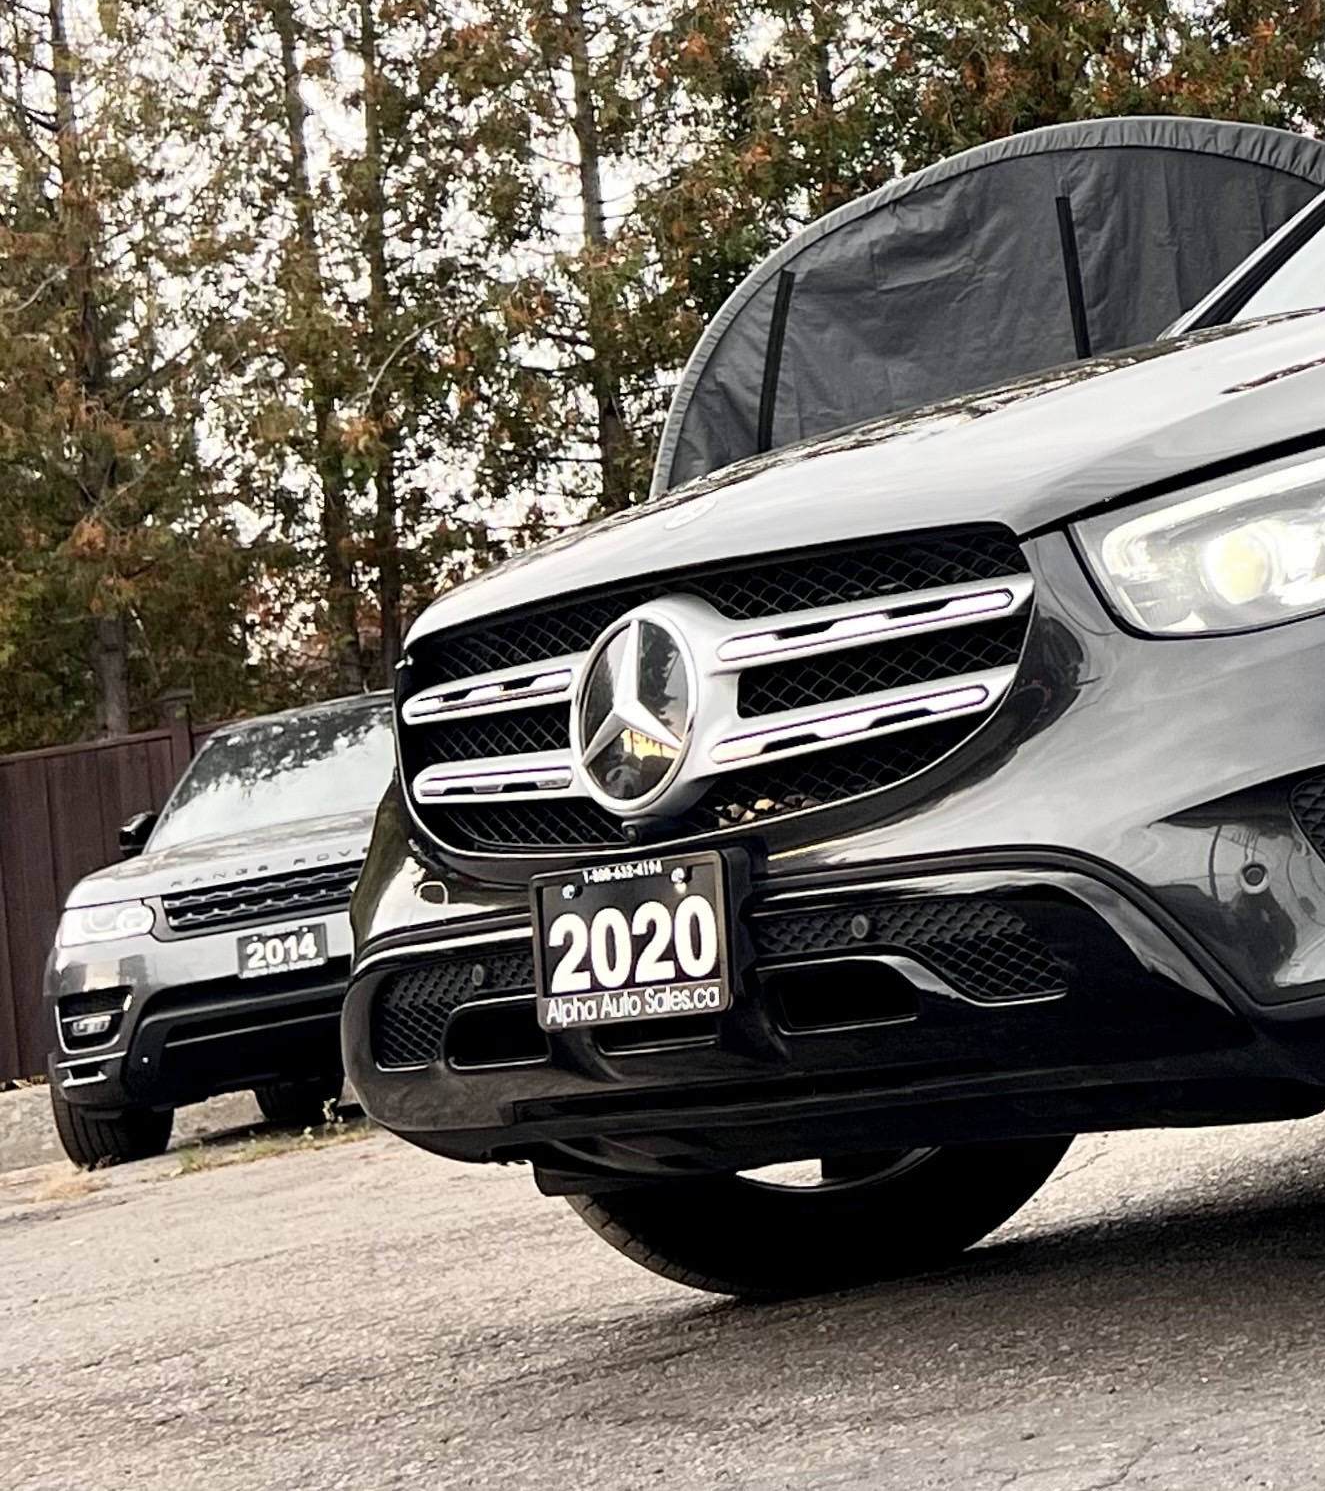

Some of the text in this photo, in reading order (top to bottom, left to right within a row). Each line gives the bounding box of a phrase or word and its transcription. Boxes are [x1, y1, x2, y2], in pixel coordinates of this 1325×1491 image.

[246, 932, 317, 969] 2014
[548, 895, 718, 994] 2020
[546, 986, 721, 1027] Alpha Auto Sales.ca
